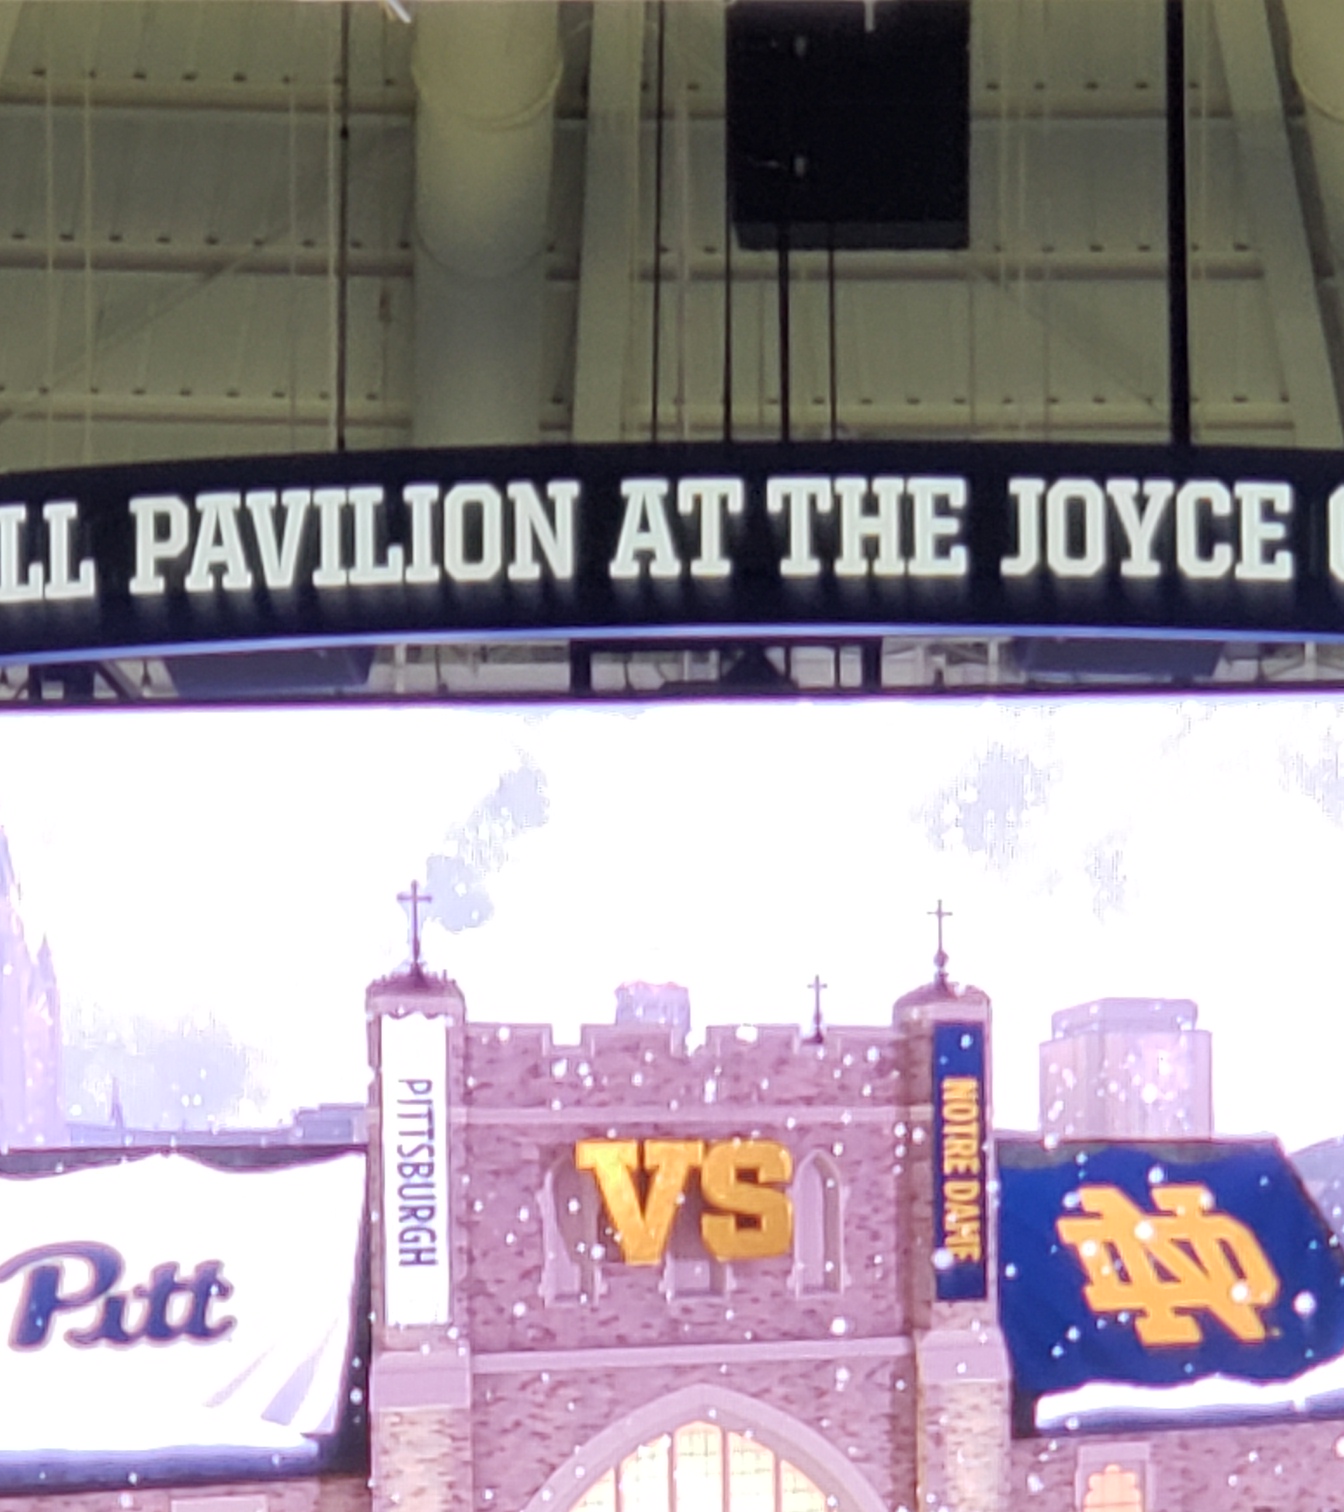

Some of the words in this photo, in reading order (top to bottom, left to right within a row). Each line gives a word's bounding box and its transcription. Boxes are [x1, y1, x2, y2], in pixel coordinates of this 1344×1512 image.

[129, 480, 579, 595] PAVILION
[609, 477, 744, 579] AT
[766, 476, 968, 577] THE
[1000, 477, 1294, 582] JOYCE
[396, 1077, 439, 1268] PITTSBURGH
[942, 1077, 979, 1175] NOTRE
[574, 1137, 794, 1266] VS
[943, 1181, 981, 1262] DAME
